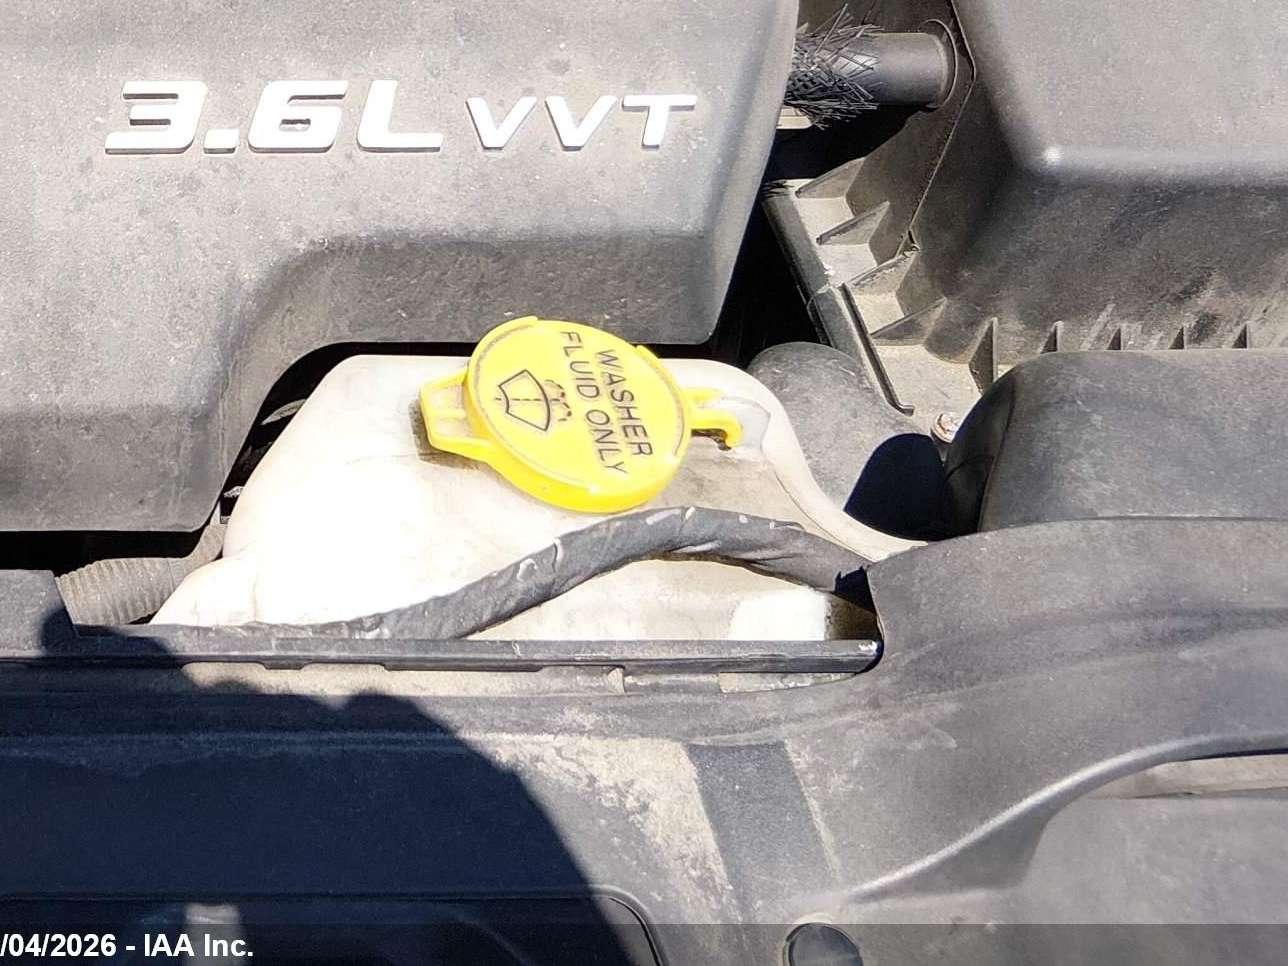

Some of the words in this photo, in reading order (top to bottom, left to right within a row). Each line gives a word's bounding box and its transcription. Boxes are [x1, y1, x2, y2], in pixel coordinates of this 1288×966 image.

[105, 79, 444, 154] 3.6L
[465, 94, 698, 151] VVT
[560, 331, 601, 400] FLUID
[583, 408, 629, 475] ONLY
[595, 349, 654, 457] WASHER
